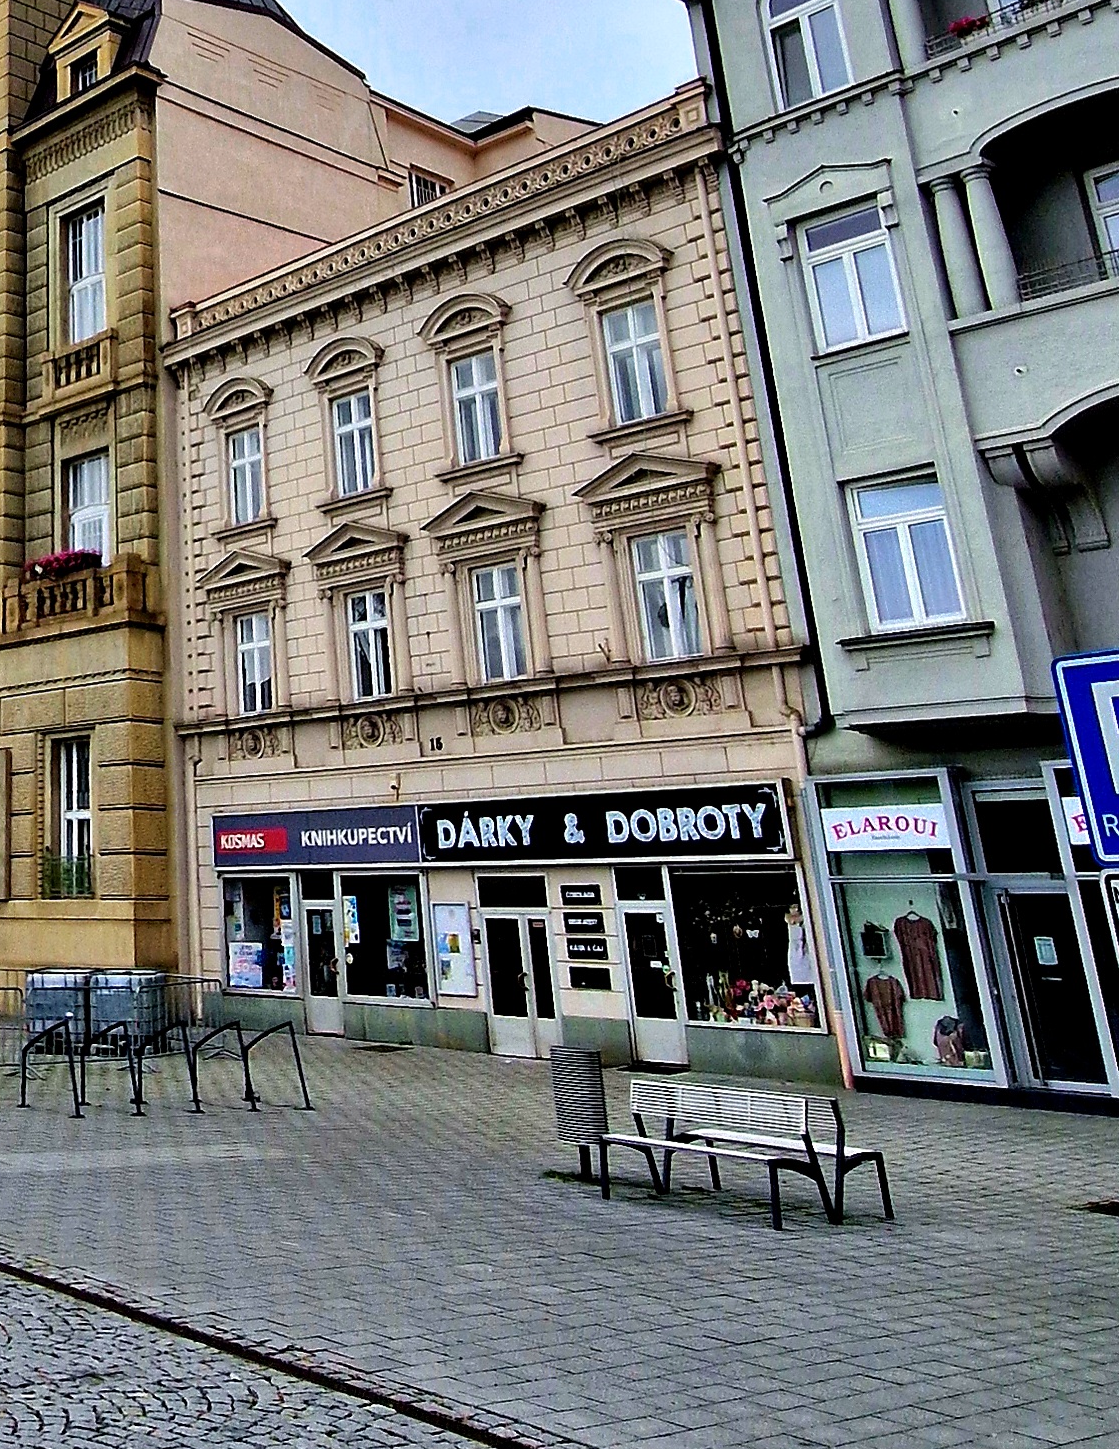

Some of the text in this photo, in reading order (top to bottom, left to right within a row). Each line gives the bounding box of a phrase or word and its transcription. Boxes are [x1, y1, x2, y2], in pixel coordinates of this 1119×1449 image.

[220, 821, 413, 849] KOSMAS KNIHKUPECTVÍ
[436, 802, 767, 849] DÁRKY & DOBROTY
[831, 815, 939, 841] ELAROUI
